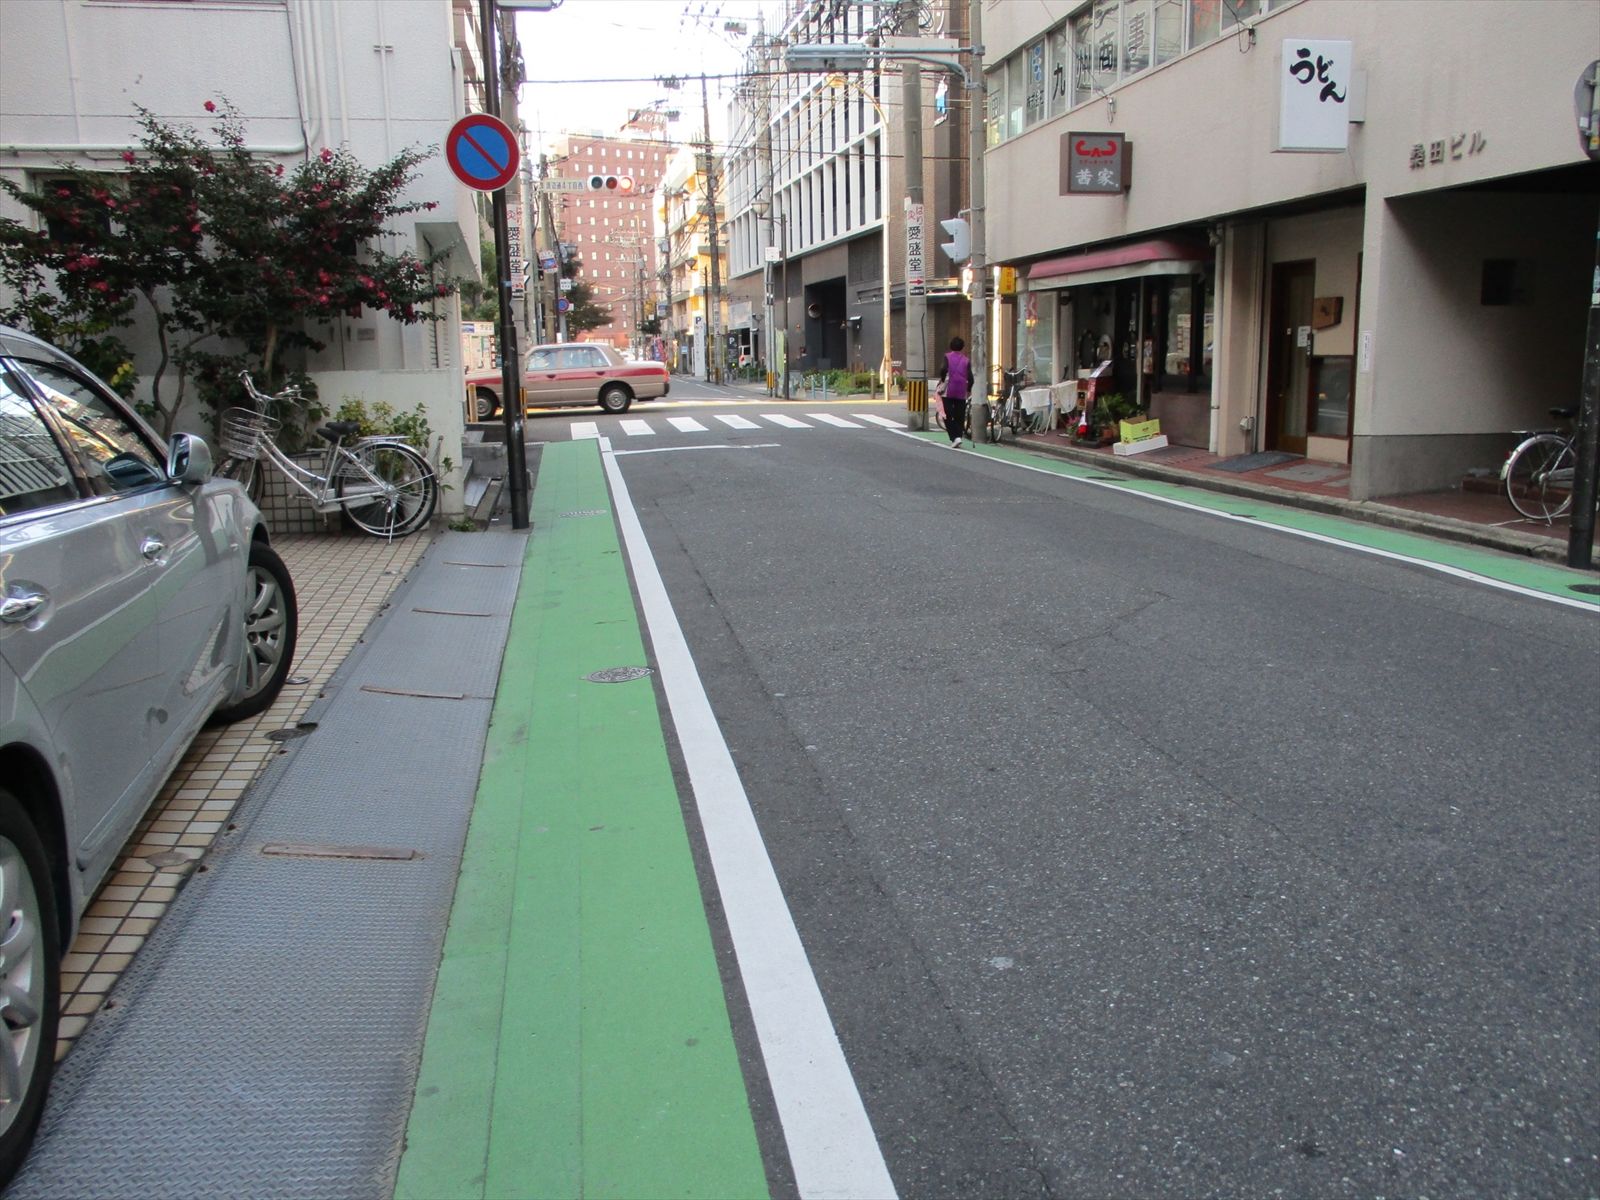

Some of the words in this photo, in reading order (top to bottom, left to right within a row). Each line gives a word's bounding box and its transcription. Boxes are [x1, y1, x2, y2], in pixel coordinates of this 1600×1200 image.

[1053, 11, 1145, 101] 九州商事
[1289, 48, 1347, 103] うどん
[1410, 131, 1486, 170] 桑田ビル
[908, 226, 921, 272] 愛盛堂
